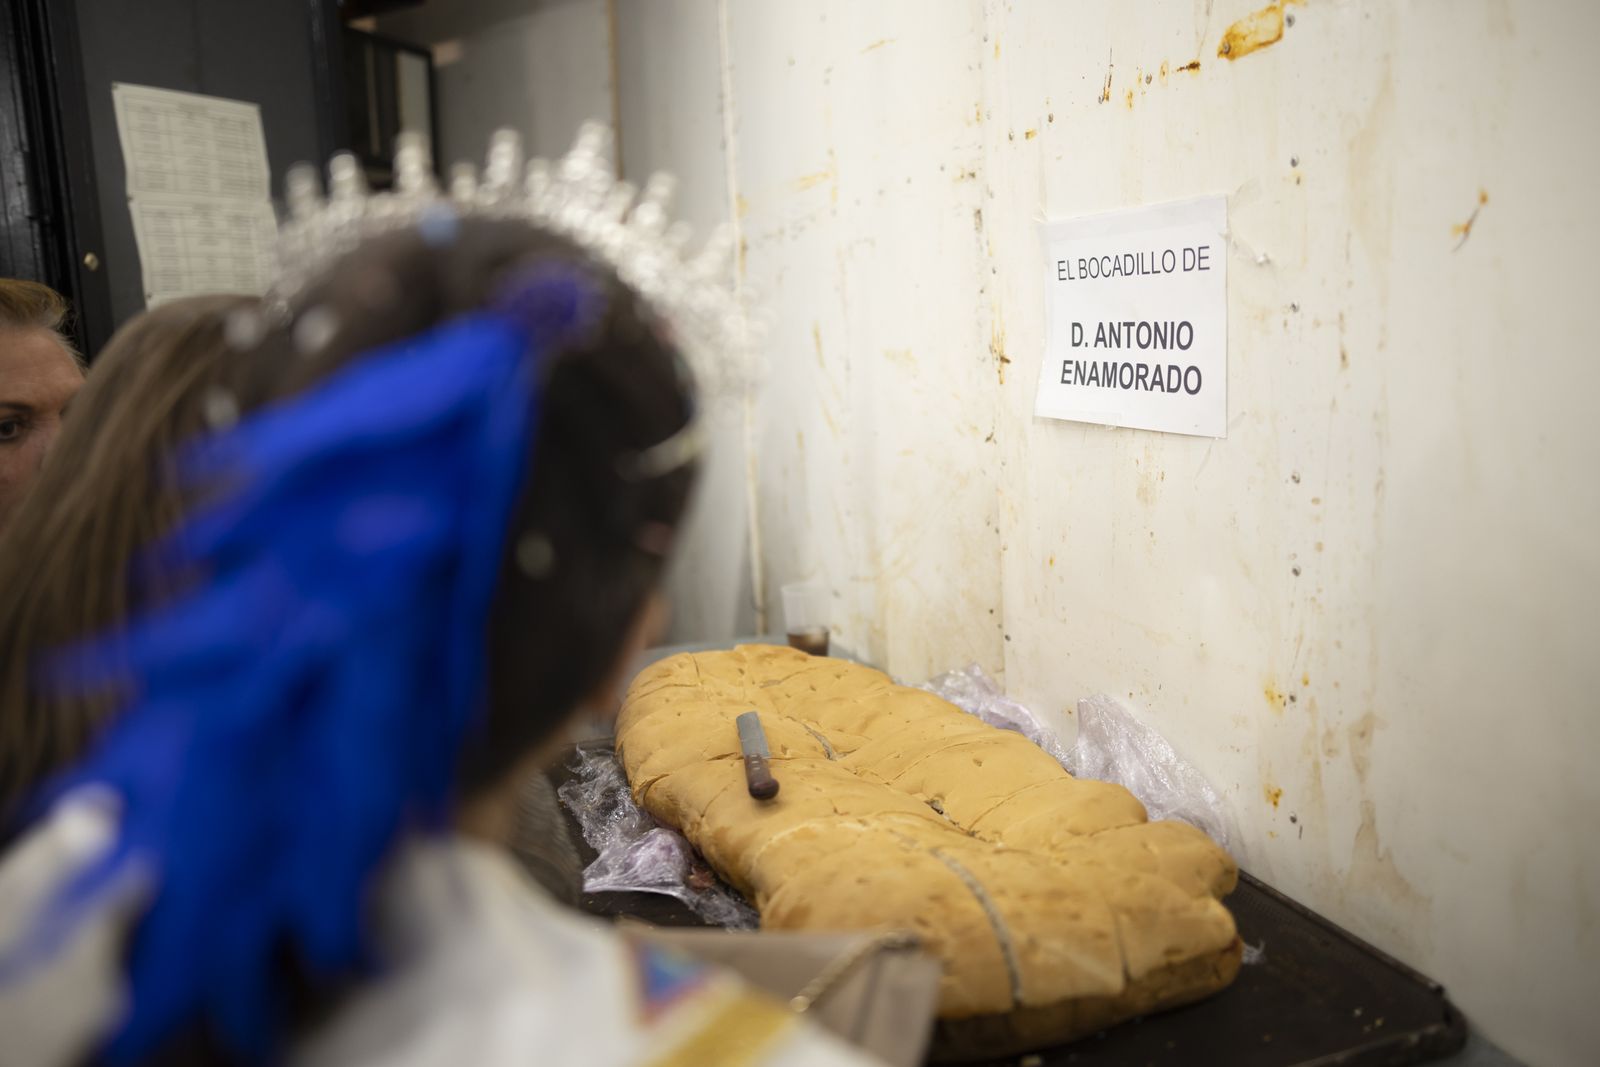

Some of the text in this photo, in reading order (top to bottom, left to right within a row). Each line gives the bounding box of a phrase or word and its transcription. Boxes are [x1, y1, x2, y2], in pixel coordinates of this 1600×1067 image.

[1057, 246, 1210, 281] EL BOCADILLO DE
[1071, 321, 1194, 350] D. ANTONIO
[1060, 360, 1202, 395] ENAMORADO
